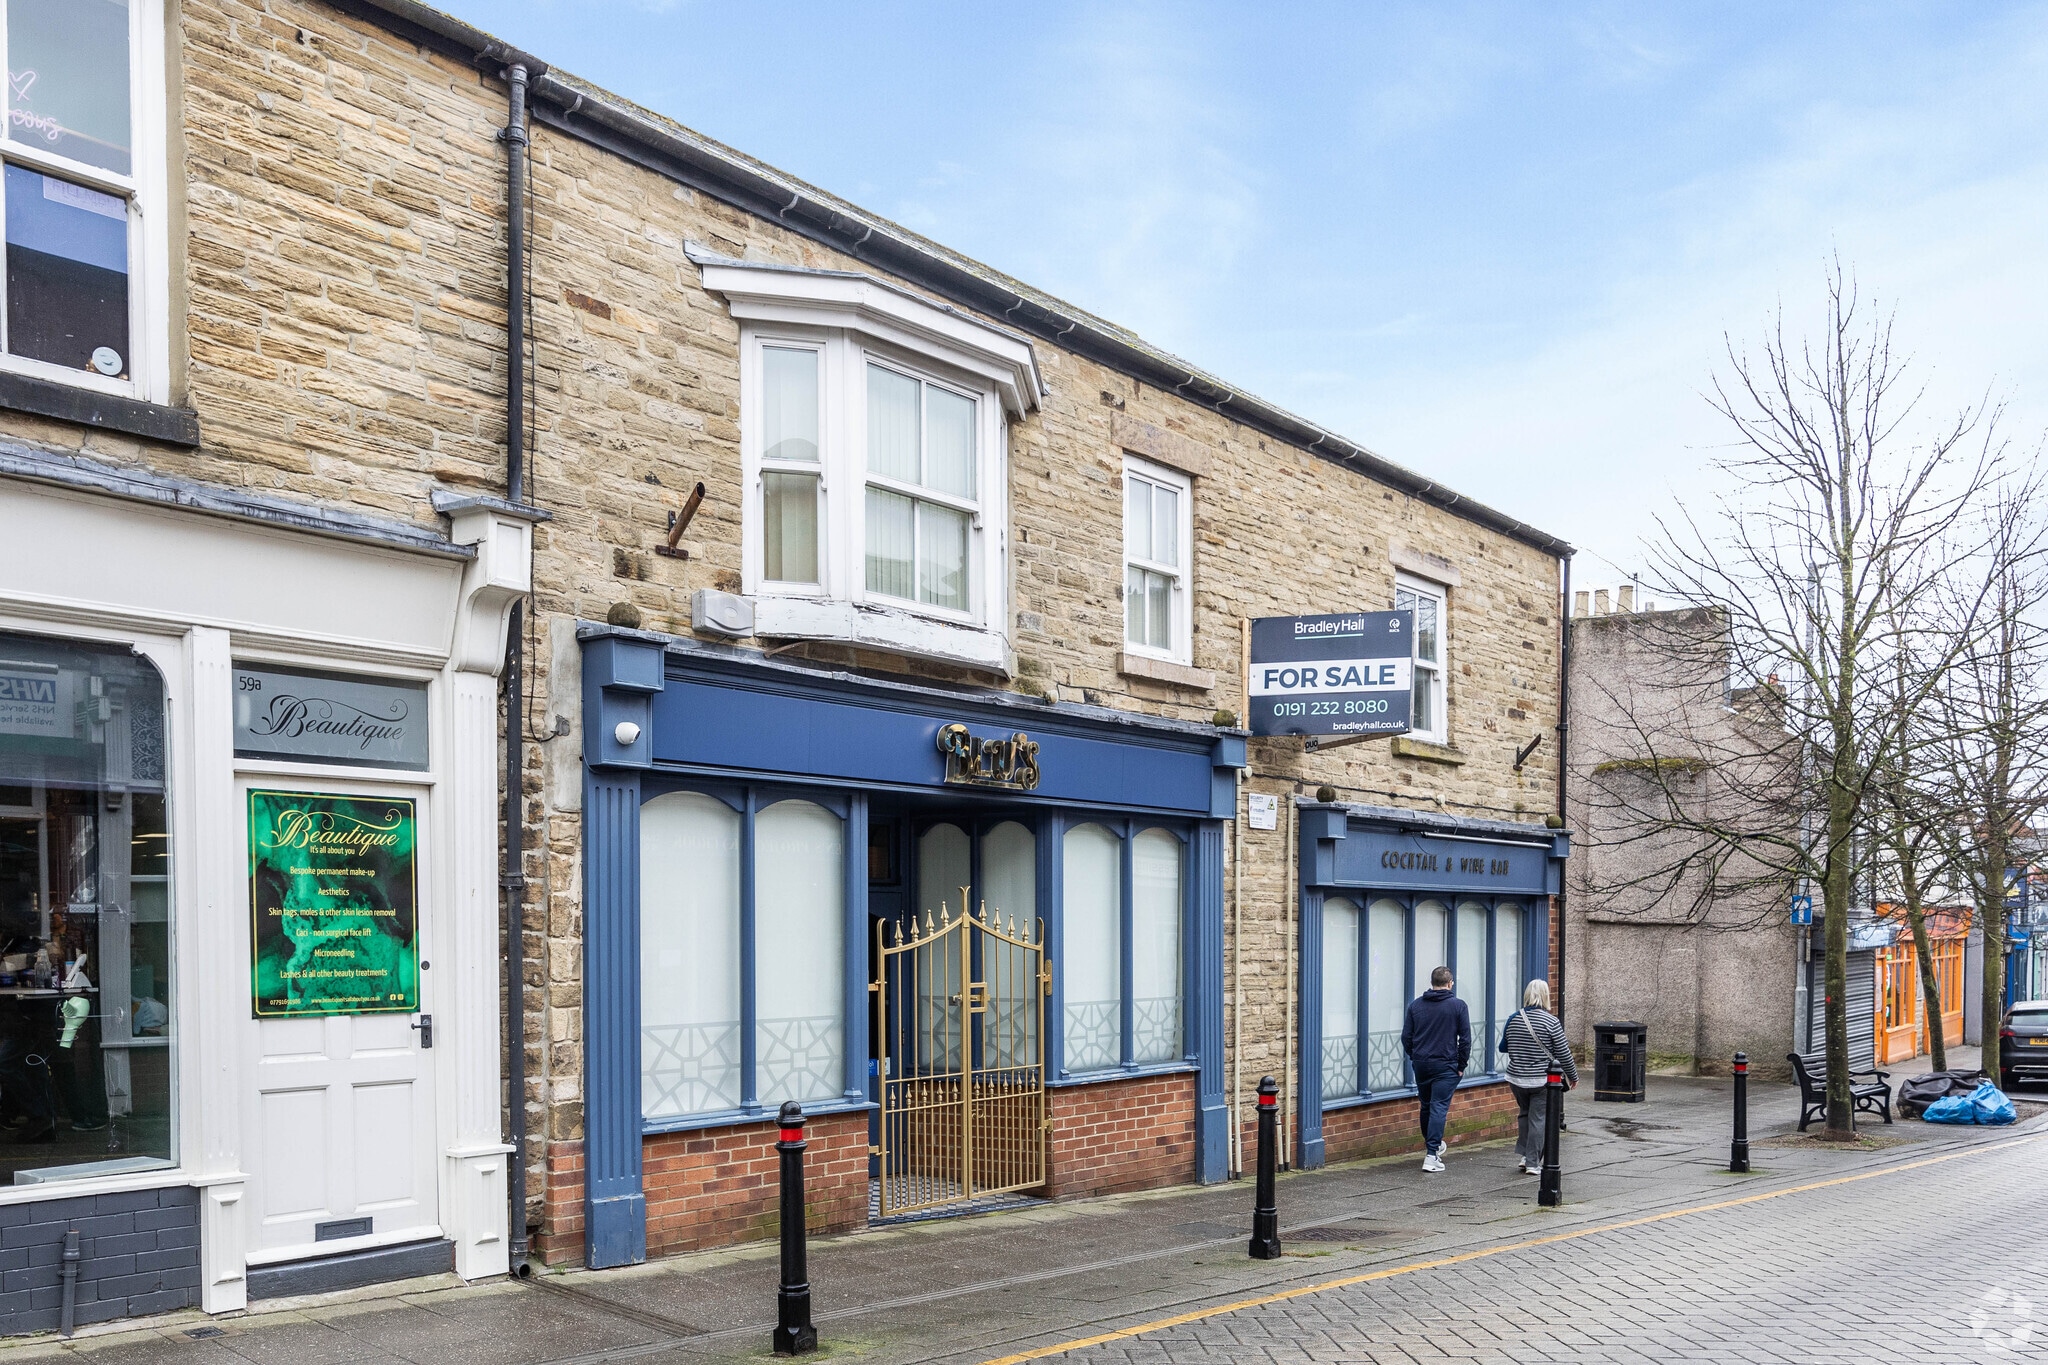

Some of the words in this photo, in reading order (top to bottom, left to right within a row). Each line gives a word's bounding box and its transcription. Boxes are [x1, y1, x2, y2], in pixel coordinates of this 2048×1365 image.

[8, 109, 63, 140] eous
[1341, 618, 1365, 631] Hall
[1264, 667, 1318, 689] FOR
[1324, 664, 1396, 687] SALE
[239, 676, 262, 691] 59a
[1273, 702, 1306, 717] 0191
[1310, 701, 1340, 715] 232
[1344, 699, 1389, 714] 8080
[249, 694, 409, 750] Beautique
[1332, 720, 1405, 732] bradleyhall.co.uk
[260, 808, 402, 856] Beautique
[310, 845, 319, 853] It's
[319, 846, 327, 854] all
[327, 846, 344, 854] about
[344, 848, 356, 856] you
[1381, 850, 1438, 872] COCKTAIL
[1460, 857, 1485, 874] WINE
[1490, 858, 1510, 876] BAR
[289, 866, 316, 876] Bespoke
[316, 867, 349, 877] permanent
[349, 868, 376, 877] make-up
[317, 888, 350, 896] Aesthetics
[268, 907, 282, 916] Skin
[300, 908, 318, 916] moles
[319, 908, 325, 916] &
[325, 908, 341, 916] other
[342, 908, 355, 916] skin
[356, 908, 373, 916] lesion
[374, 908, 396, 917] removal
[326, 928, 349, 938] surgical
[349, 928, 362, 937] face
[362, 928, 372, 937] lift
[314, 948, 355, 958] Microneedling
[279, 970, 301, 978] Lashes
[302, 969, 308, 978] &
[308, 970, 316, 978] all
[317, 969, 333, 978] other
[334, 969, 355, 979] beauty
[355, 968, 388, 977] treatments
